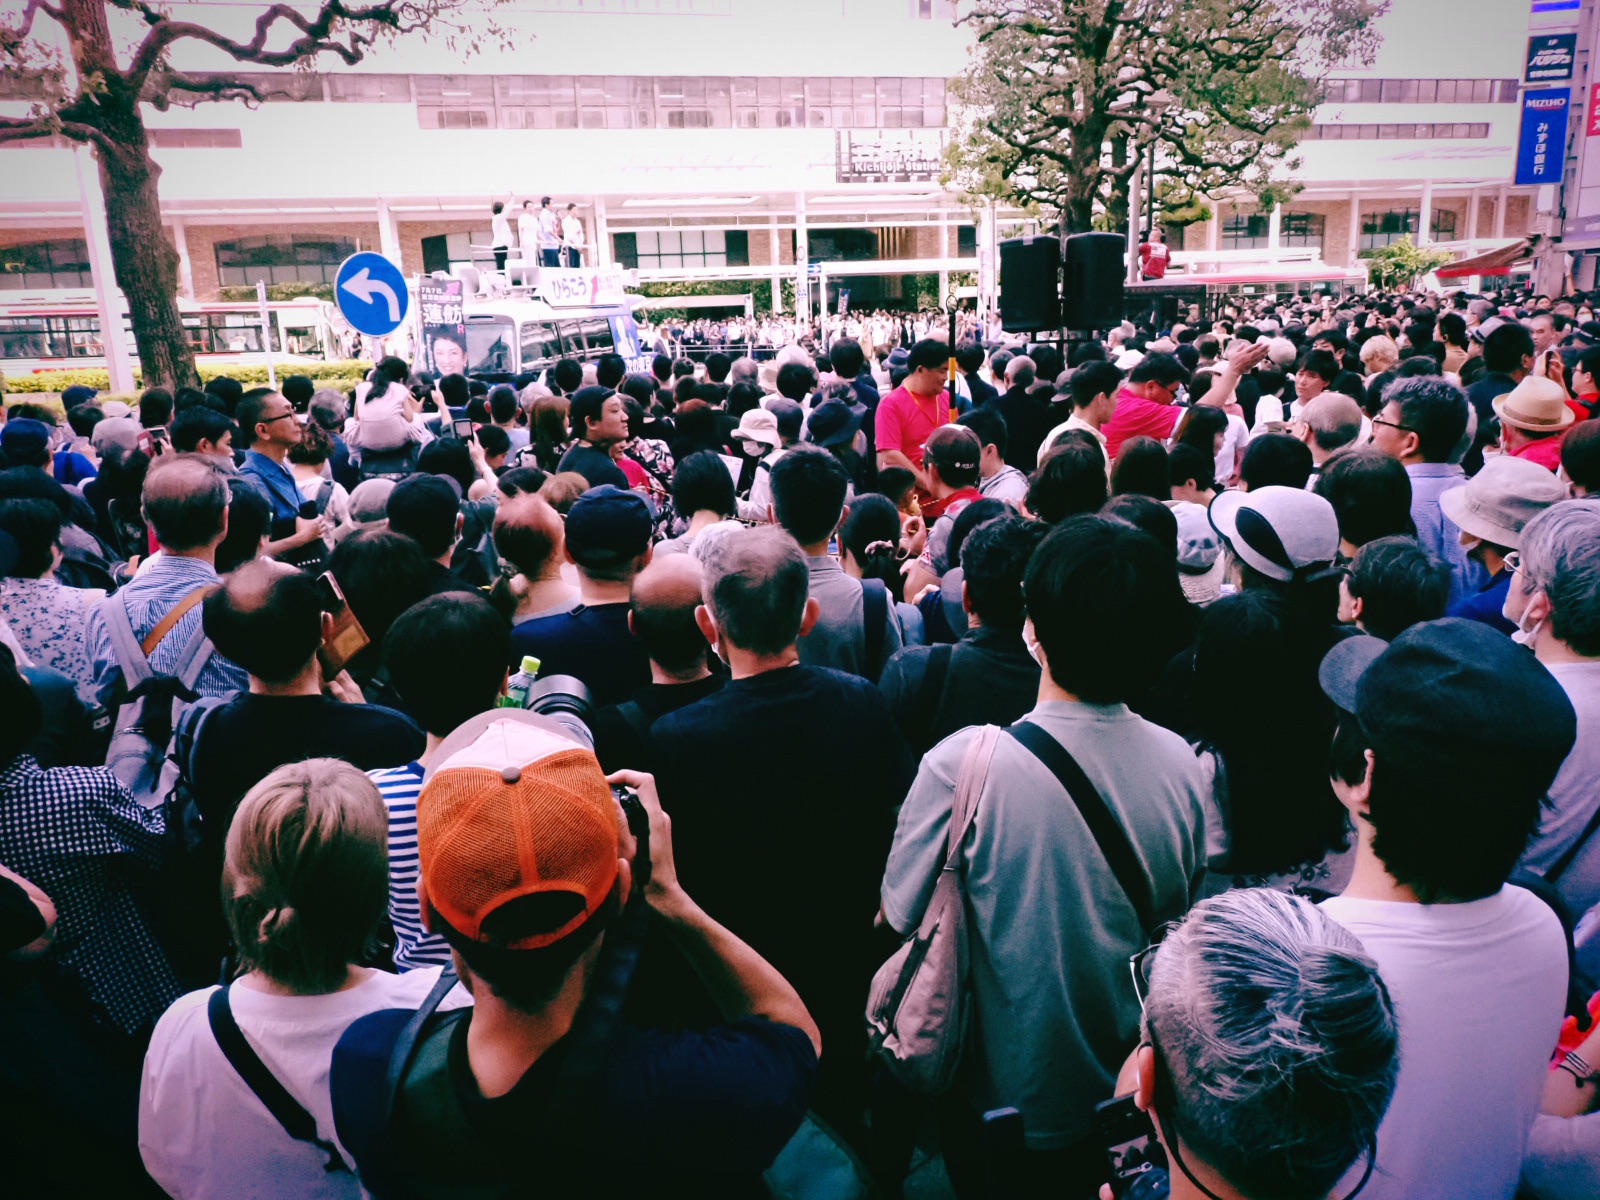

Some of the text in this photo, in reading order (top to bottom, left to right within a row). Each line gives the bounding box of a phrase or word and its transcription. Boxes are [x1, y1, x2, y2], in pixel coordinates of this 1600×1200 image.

[1526, 97, 1566, 108] MIZUHO
[1534, 122, 1548, 175] みずほ銀行
[552, 276, 587, 299] ひらこう
[422, 303, 462, 325] 蓮舫
[457, 324, 465, 334] R
[626, 355, 654, 373] 次の東京
